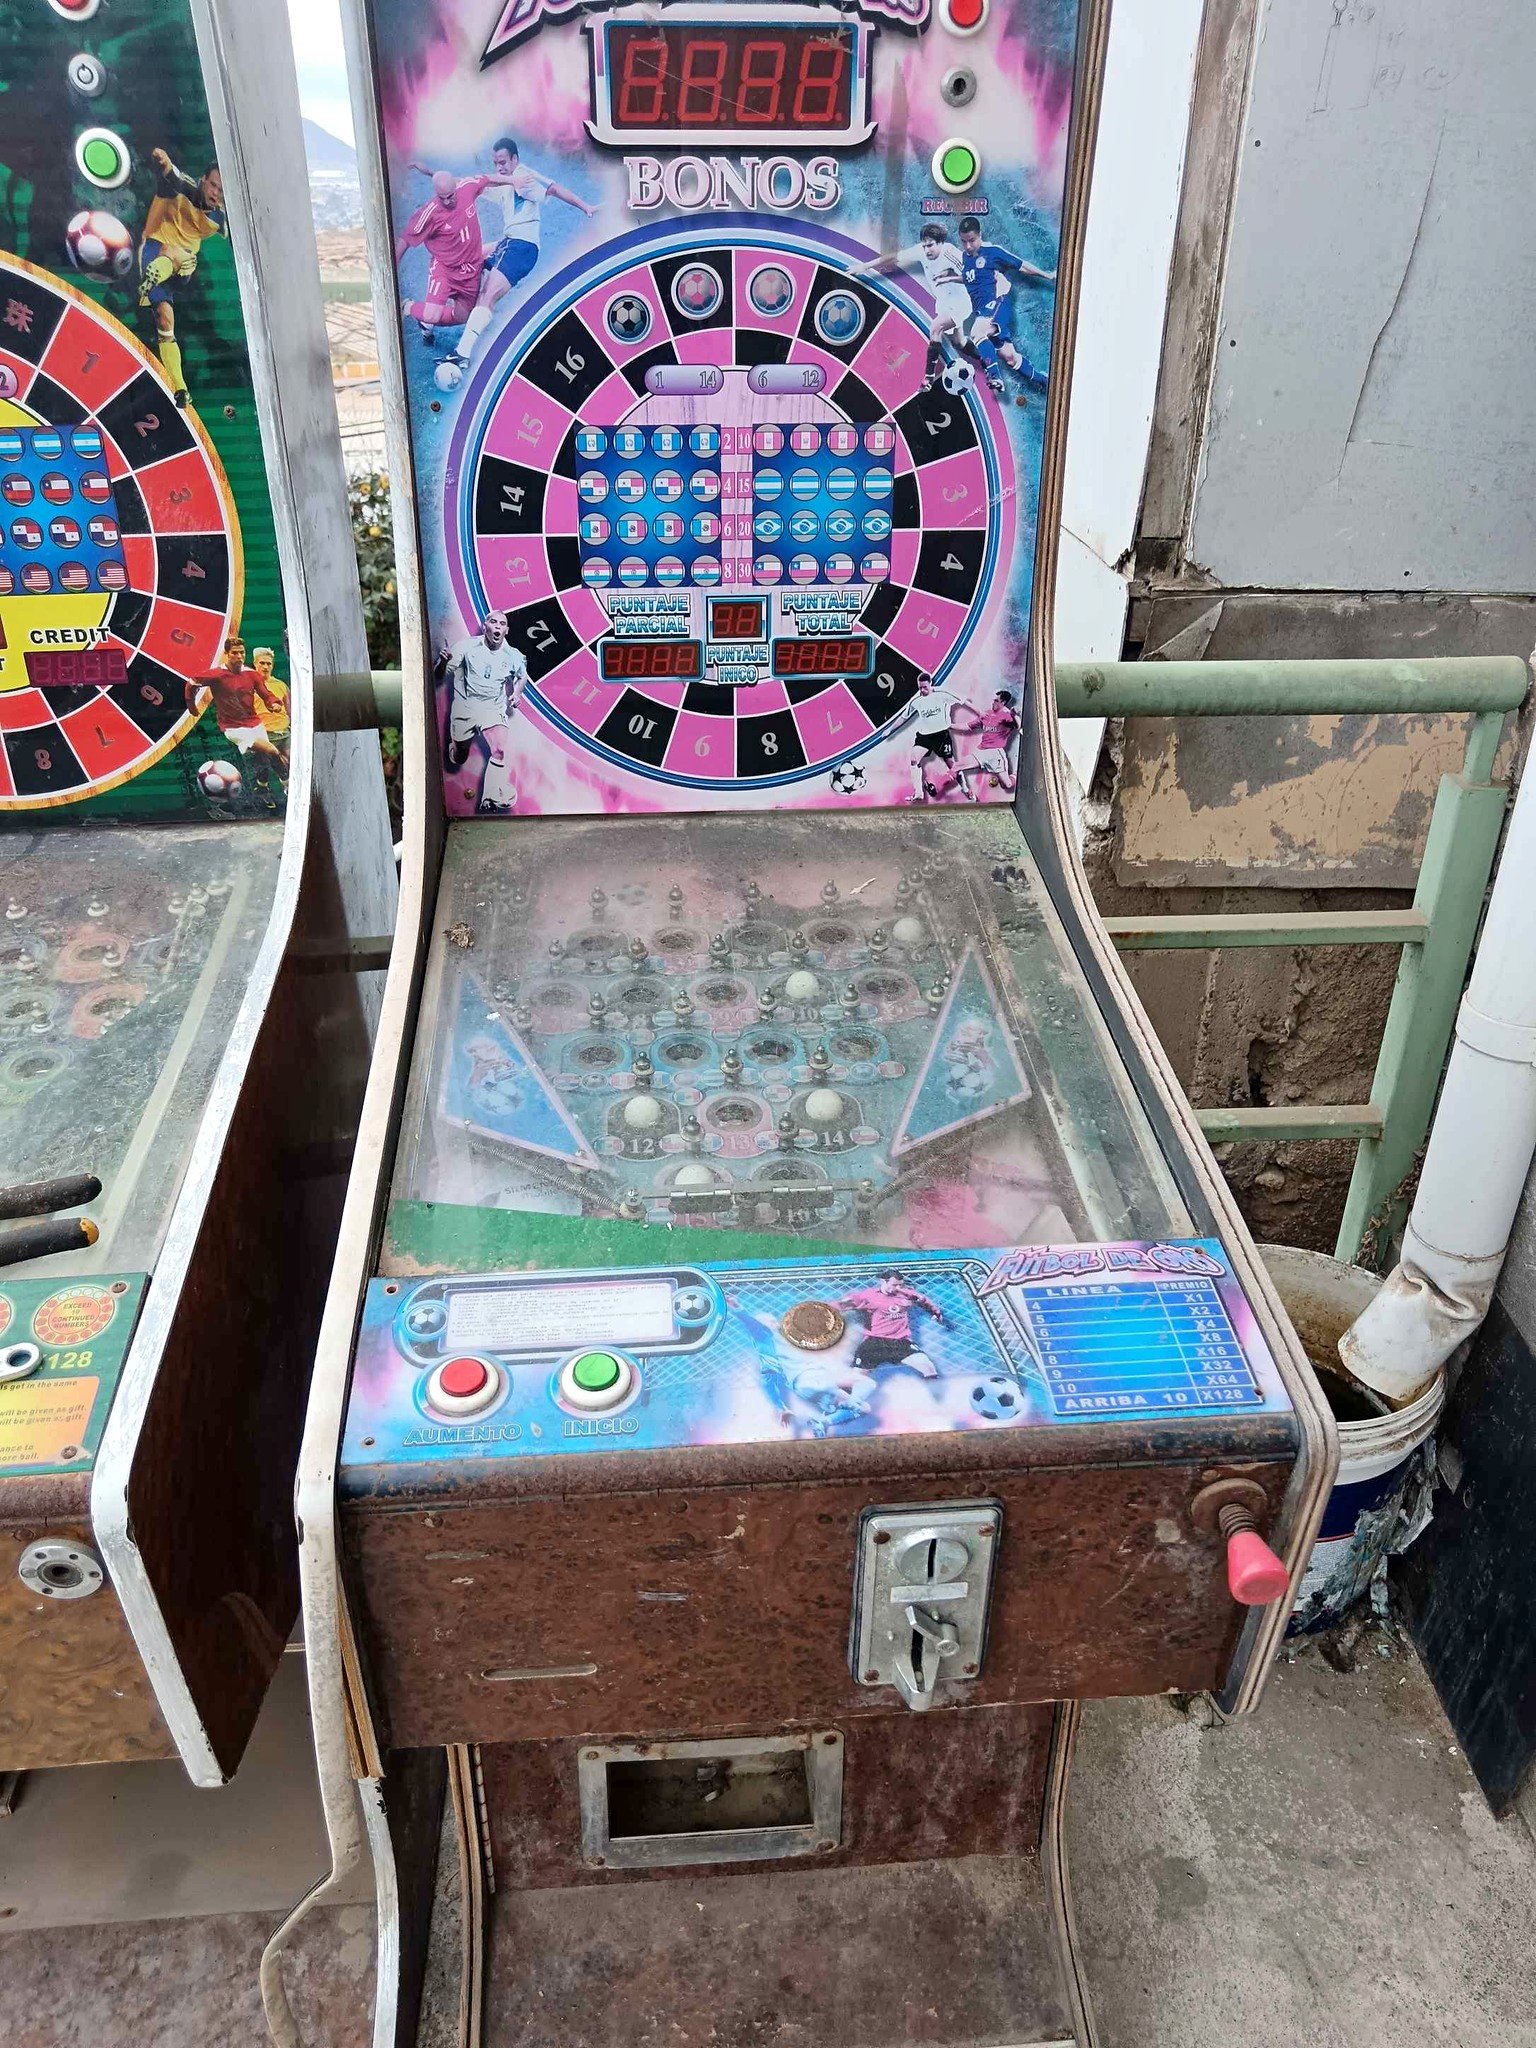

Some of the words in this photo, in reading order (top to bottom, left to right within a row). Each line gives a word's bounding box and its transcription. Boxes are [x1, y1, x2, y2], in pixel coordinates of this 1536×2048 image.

[623, 155, 841, 211] BONOS
[82, 350, 101, 374] 1
[554, 346, 586, 384] 16
[655, 371, 664, 389] 1
[699, 371, 717, 389] 14
[757, 370, 768, 388] 6
[802, 370, 820, 388] 12
[134, 413, 160, 438] 2
[517, 412, 544, 448] 15
[925, 412, 952, 436] 2
[723, 433, 733, 449] 2
[738, 433, 751, 449] 10
[723, 477, 733, 494] 4
[738, 477, 751, 494] 15
[942, 483, 969, 504] 3
[170, 487, 192, 506] 3
[500, 484, 526, 516] 14
[723, 521, 733, 537] 6
[738, 521, 751, 537] 20
[181, 560, 207, 580] 4
[723, 563, 733, 579] 8
[738, 563, 751, 579] 30
[940, 552, 965, 571] 4
[507, 556, 531, 588] 13
[608, 594, 690, 615] PUNTAJE
[781, 592, 861, 612] PUNTAJE
[614, 615, 690, 635] PARCIAL
[797, 613, 852, 632] TOTAL
[916, 616, 940, 640] 5
[29, 627, 110, 644] CREDIT
[170, 627, 197, 648] 5
[526, 619, 558, 652] 12
[706, 645, 769, 663] PUNTAJE
[572, 675, 602, 706] 11
[628, 714, 659, 740] 10
[761, 732, 779, 756] 8
[33, 749, 51, 770] 8
[630, 1138, 654, 1154] 12
[730, 1135, 751, 1151] 13
[822, 1130, 845, 1146] 14
[1105, 1249, 1155, 1270] DE
[1046, 1285, 1122, 1297] LINEA
[1162, 1281, 1208, 1291] PREMIO
[1032, 1301, 1041, 1311] 4
[1184, 1293, 1204, 1302] X1
[52, 1315, 95, 1323] CONTINUED
[1036, 1315, 1045, 1324] 5
[1189, 1306, 1211, 1316] X2
[1040, 1328, 1049, 1338] 6
[1195, 1319, 1216, 1329] X4
[1043, 1341, 1052, 1351] 7
[1200, 1332, 1222, 1342] X8
[1048, 1355, 1058, 1365] 8
[1196, 1346, 1227, 1357] X16
[1052, 1369, 1062, 1379] 9
[1201, 1360, 1233, 1371] X32
[10, 1383, 25, 1391] get
[53, 1380, 78, 1388] same
[1058, 1383, 1077, 1393] 10
[1206, 1374, 1238, 1385] X64
[1065, 1395, 1148, 1408] ARRIBA
[1163, 1392, 1188, 1403] 10
[1202, 1389, 1243, 1401] X128
[16, 1408, 28, 1416] be
[403, 1423, 523, 1447] AUMENTO
[564, 1417, 640, 1438] INICIO
